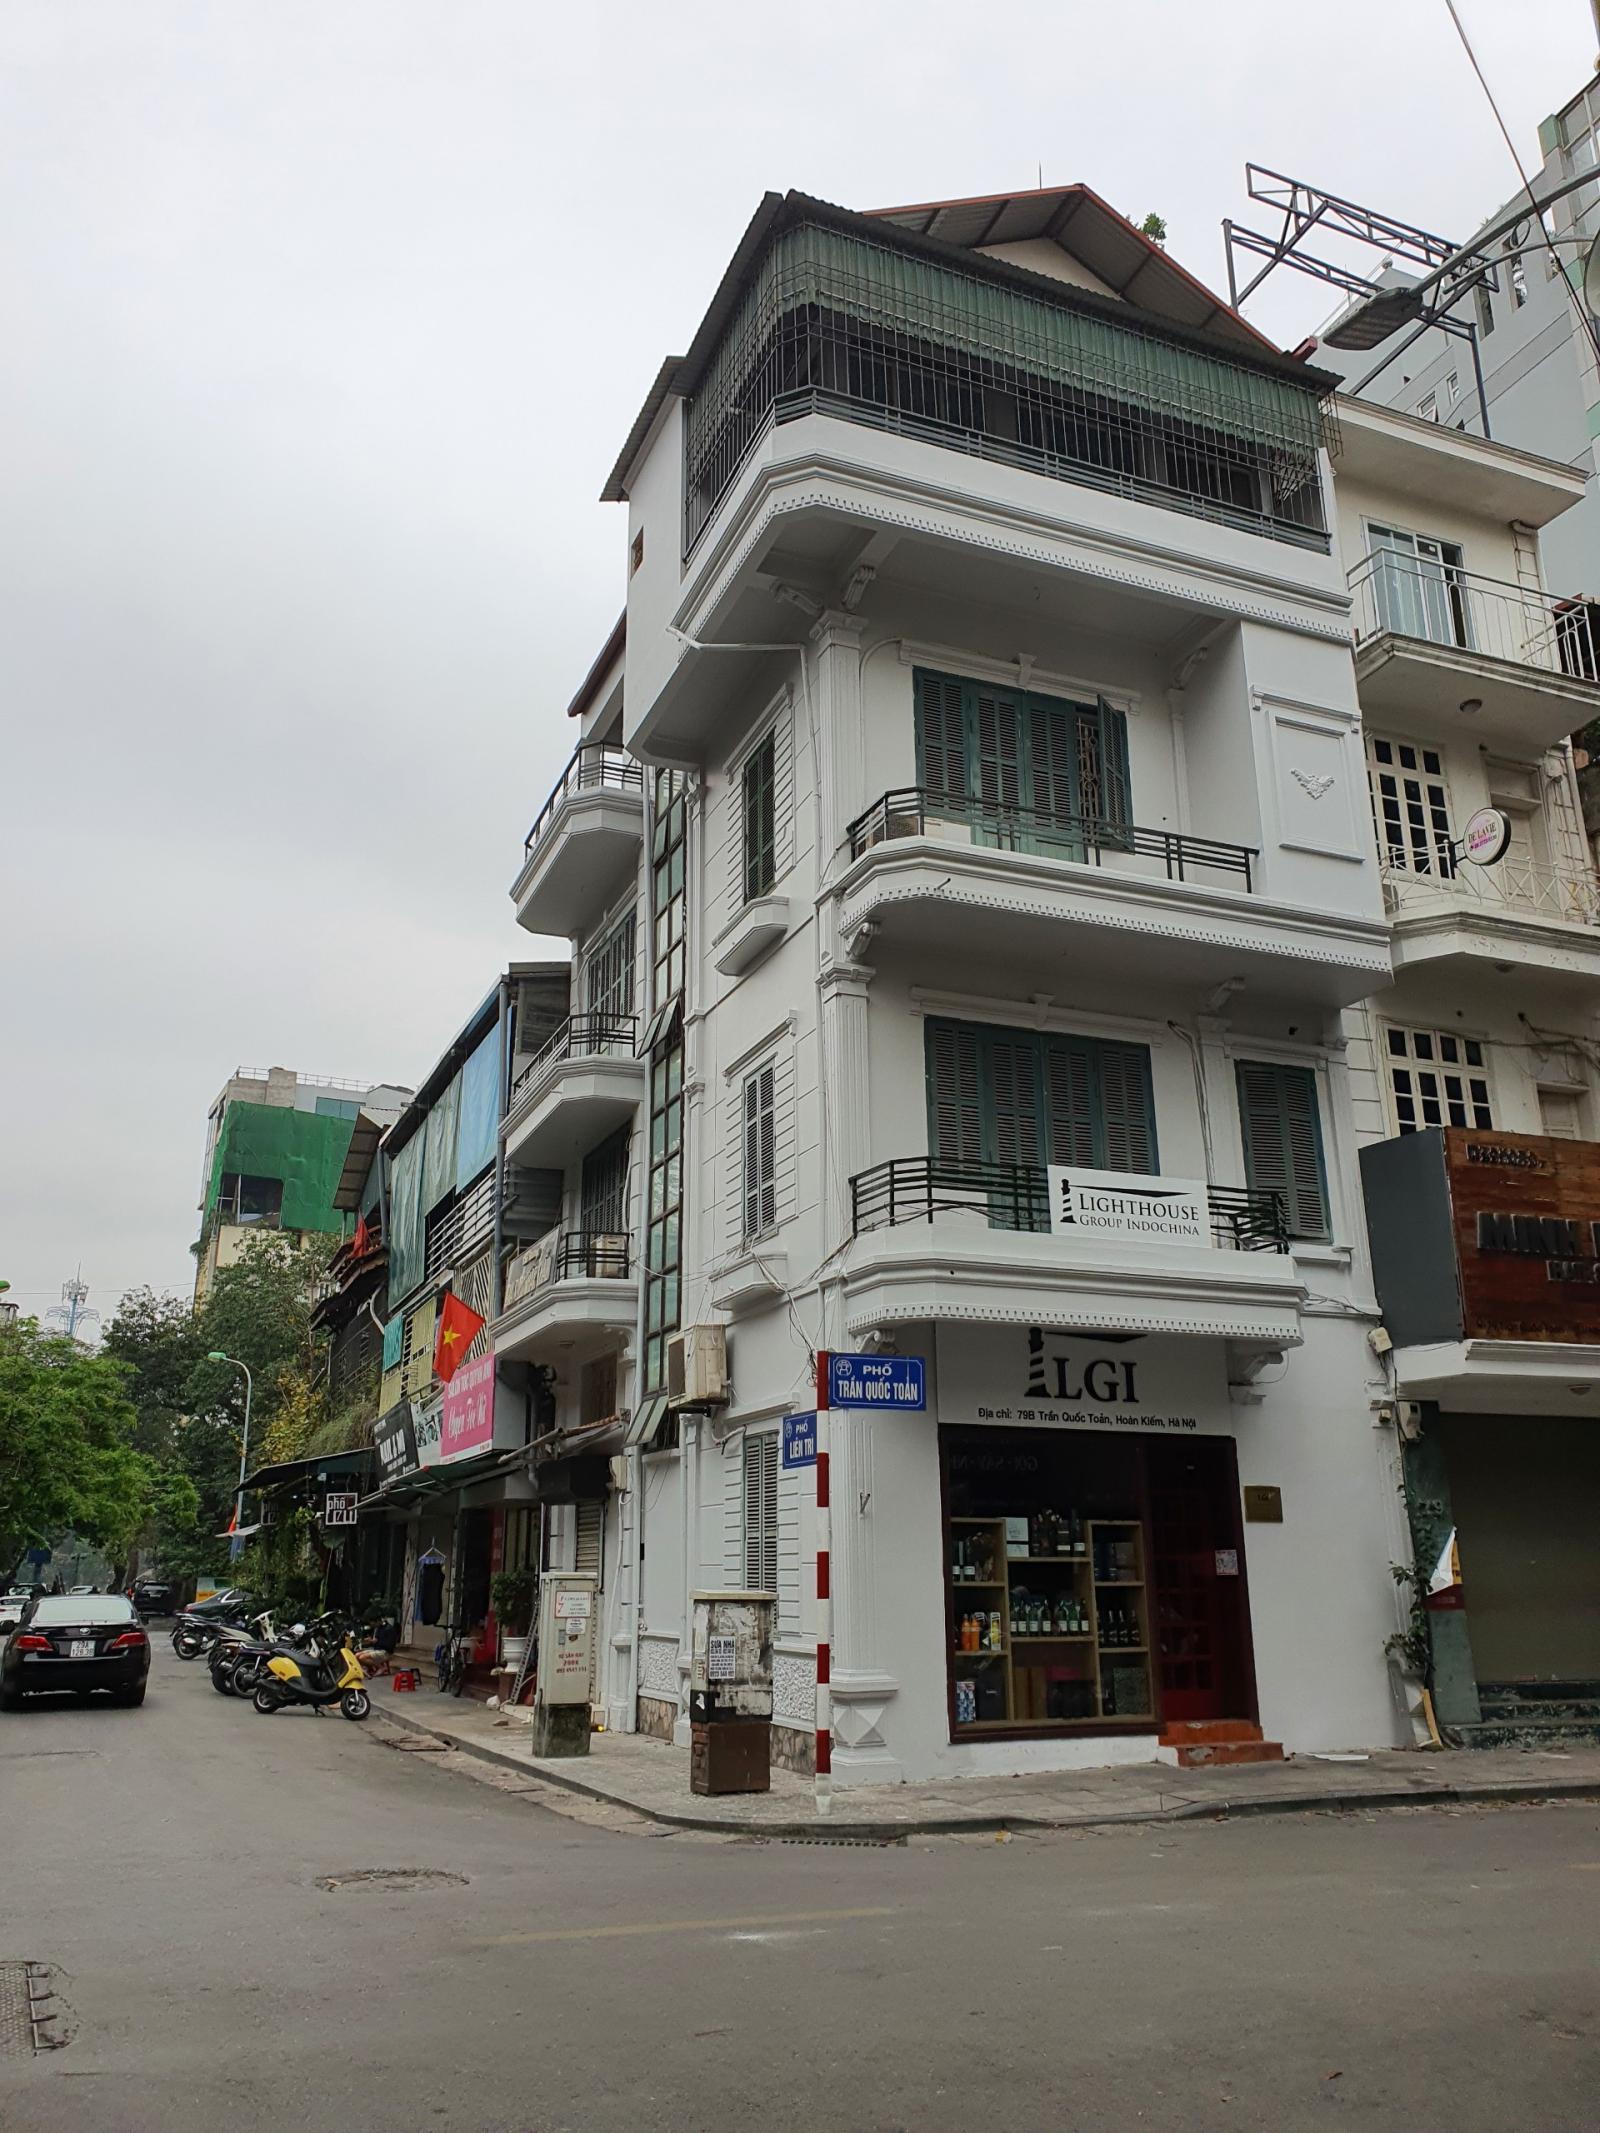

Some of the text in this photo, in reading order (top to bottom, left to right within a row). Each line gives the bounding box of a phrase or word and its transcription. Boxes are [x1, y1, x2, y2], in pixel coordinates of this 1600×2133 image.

[1079, 1193, 1200, 1221] LIGHTHOUSE
[1079, 1214, 1200, 1236] GROUP INDOCHINA
[862, 1363, 892, 1376] PHỐ
[1052, 1356, 1140, 1404] LGI
[865, 1376, 891, 1400] QUỐC
[795, 1418, 808, 1435] PHỐ
[978, 1407, 994, 1420] Địa
[1017, 1410, 1035, 1420] 79B
[1062, 1411, 1086, 1423] Quốc
[1168, 1417, 1180, 1427] Hà
[1182, 1418, 1197, 1430] Nội
[790, 1436, 803, 1459] LIÊN
